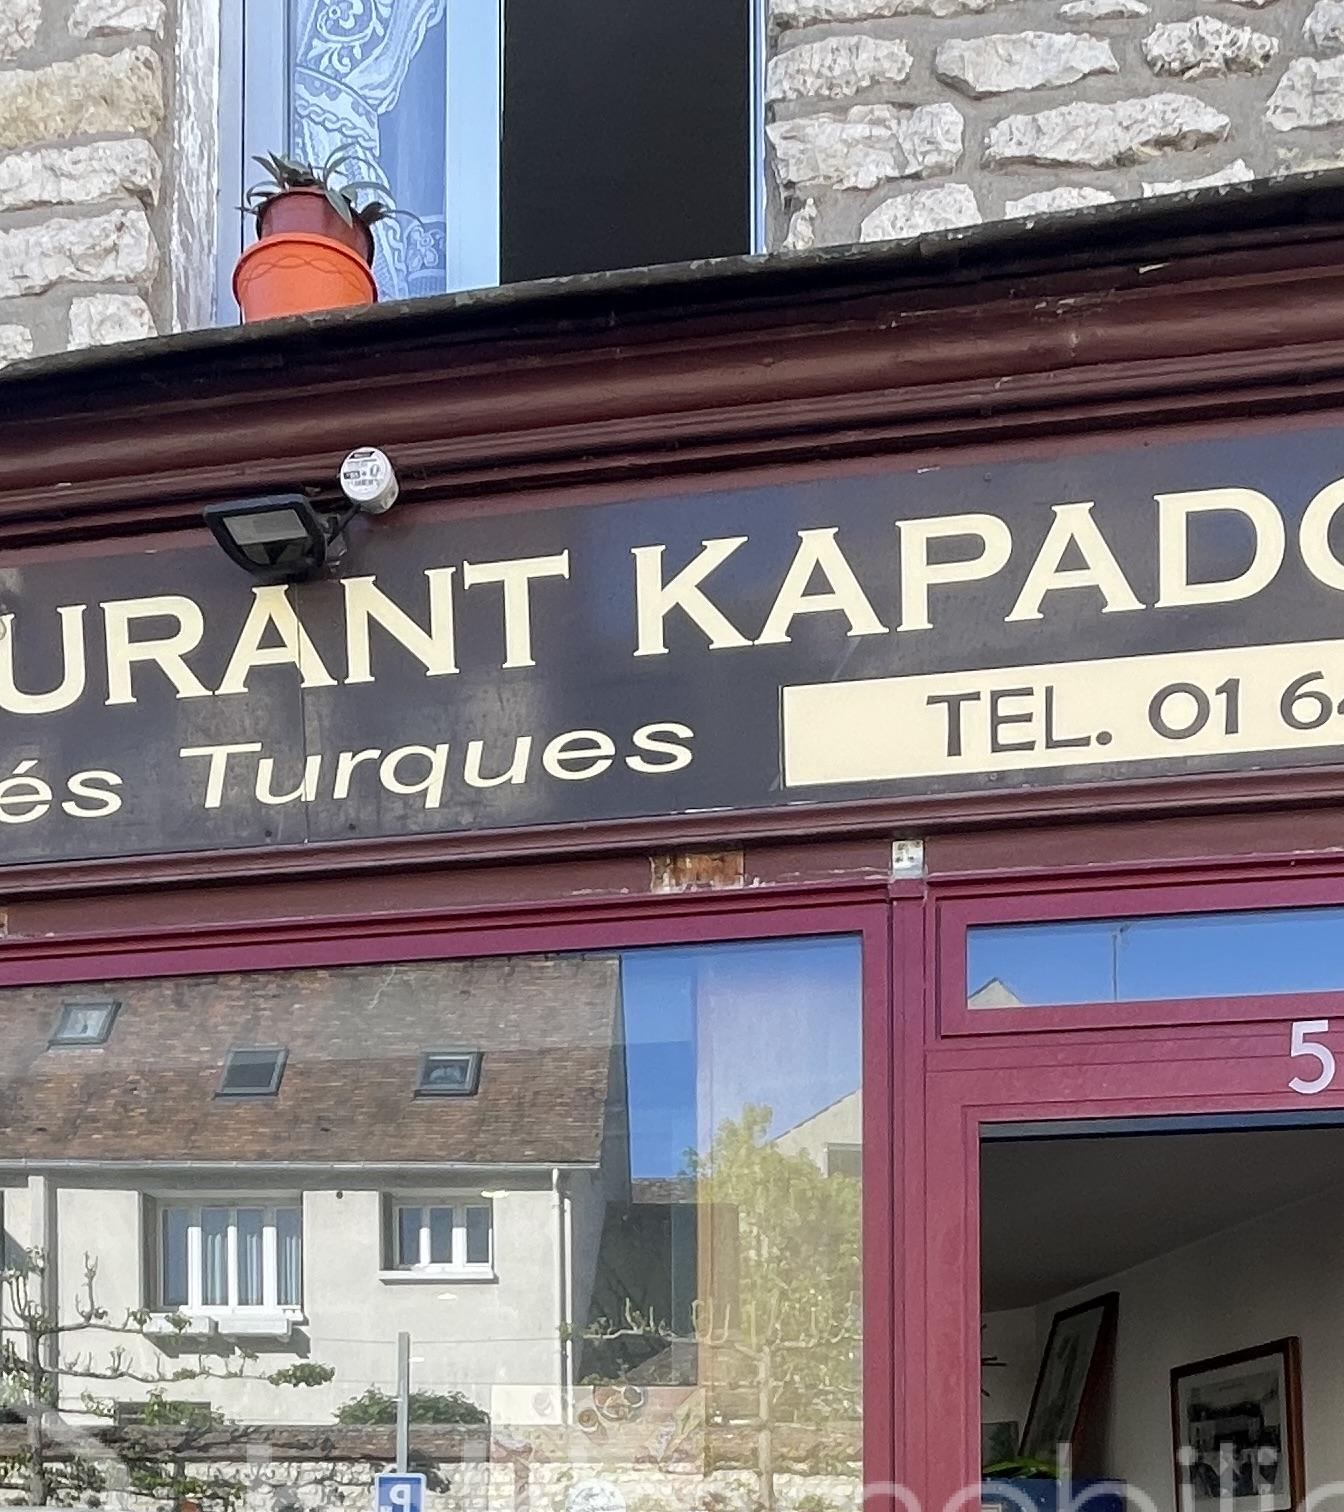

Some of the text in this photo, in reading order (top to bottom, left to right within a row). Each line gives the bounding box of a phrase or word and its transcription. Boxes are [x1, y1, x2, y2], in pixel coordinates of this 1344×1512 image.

[926, 685, 1113, 758] TEL.
[1147, 678, 1241, 740] 01
[179, 721, 695, 810] Turques
[1288, 1019, 1337, 1095] 5
